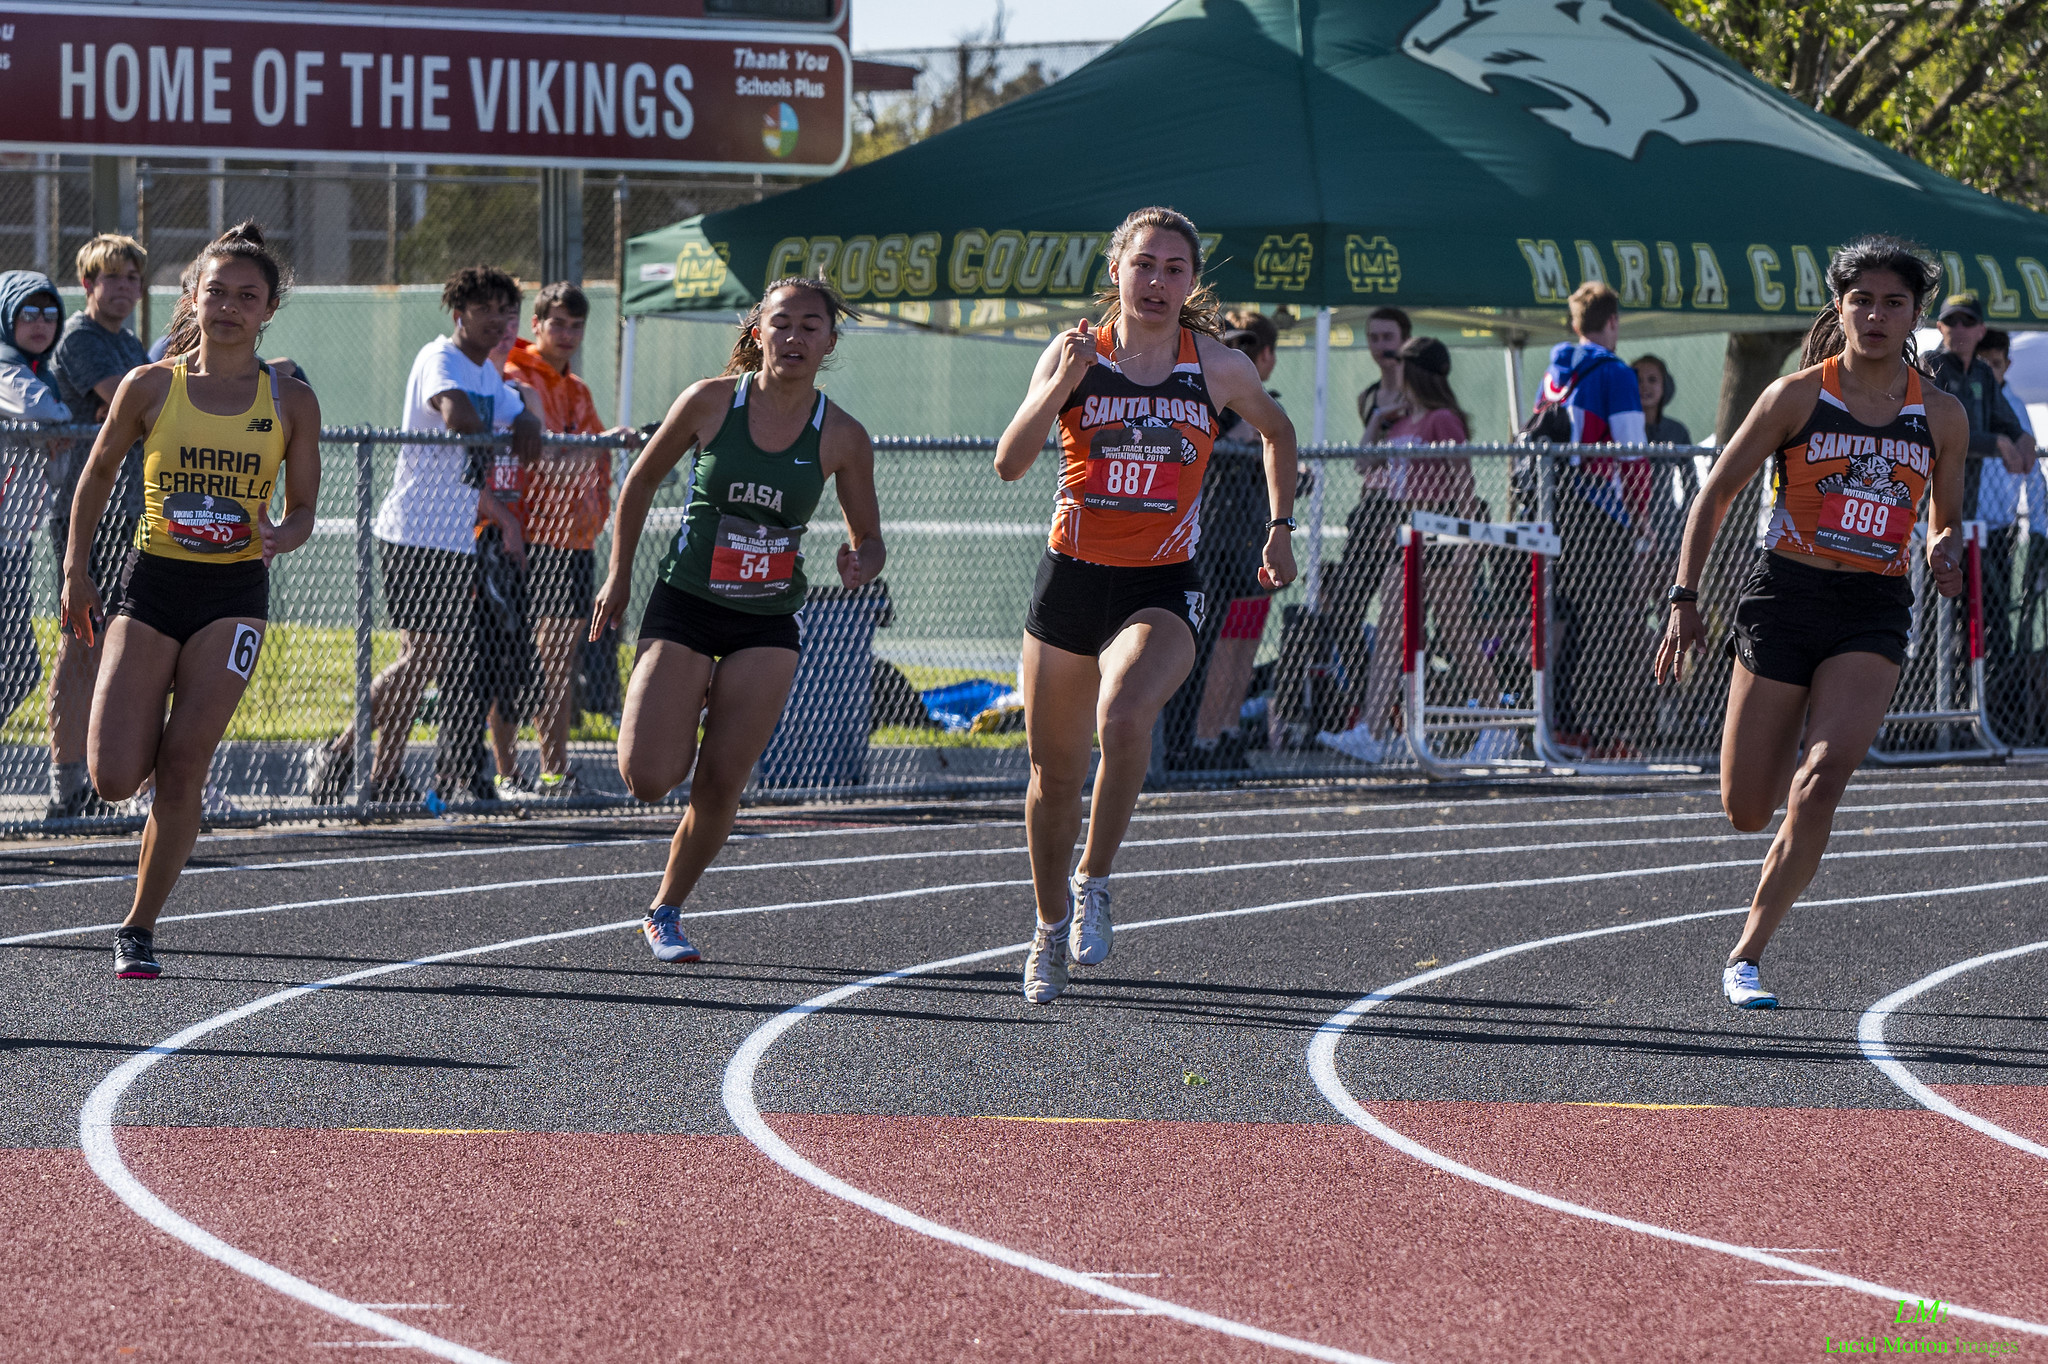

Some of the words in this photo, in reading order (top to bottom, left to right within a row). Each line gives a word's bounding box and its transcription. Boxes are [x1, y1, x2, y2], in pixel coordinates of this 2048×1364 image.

[733, 47, 790, 70] Thank
[795, 50, 829, 72] You
[60, 43, 232, 123] HOME
[252, 48, 324, 127] OF
[341, 53, 451, 132] THE
[468, 57, 695, 140] VIKINGS
[735, 75, 793, 97] Schools
[794, 78, 825, 99] Plus
[765, 232, 941, 298] CROSS
[1516, 238, 1729, 310] MARIA
[1081, 395, 1151, 428] SANTA
[1155, 396, 1212, 436] ROSA
[180, 446, 261, 475] MARIA
[1105, 452, 1145, 461] INVITATIONAL
[1146, 454, 1164, 462] 2019
[1122, 445, 1143, 453] TRACK
[1144, 446, 1171, 455] CLASSIC
[1807, 431, 1877, 463] SANTA
[1881, 438, 1931, 478] ROSA
[159, 471, 271, 499] CARRILLO
[1107, 460, 1158, 495] 887
[728, 482, 783, 513] CASA
[1843, 487, 1881, 503] INVITATIONAL
[1882, 495, 1898, 506] 2019
[173, 510, 194, 519] VIKING
[195, 510, 214, 519] TRACK
[215, 513, 241, 523] CLASSIC
[1841, 498, 1889, 537] 899
[727, 532, 747, 543] VIKING
[748, 537, 767, 547] TRACK
[767, 536, 790, 546] CLASSIC
[769, 546, 785, 554] 2019
[740, 553, 770, 579] 54
[234, 629, 257, 673] 6
